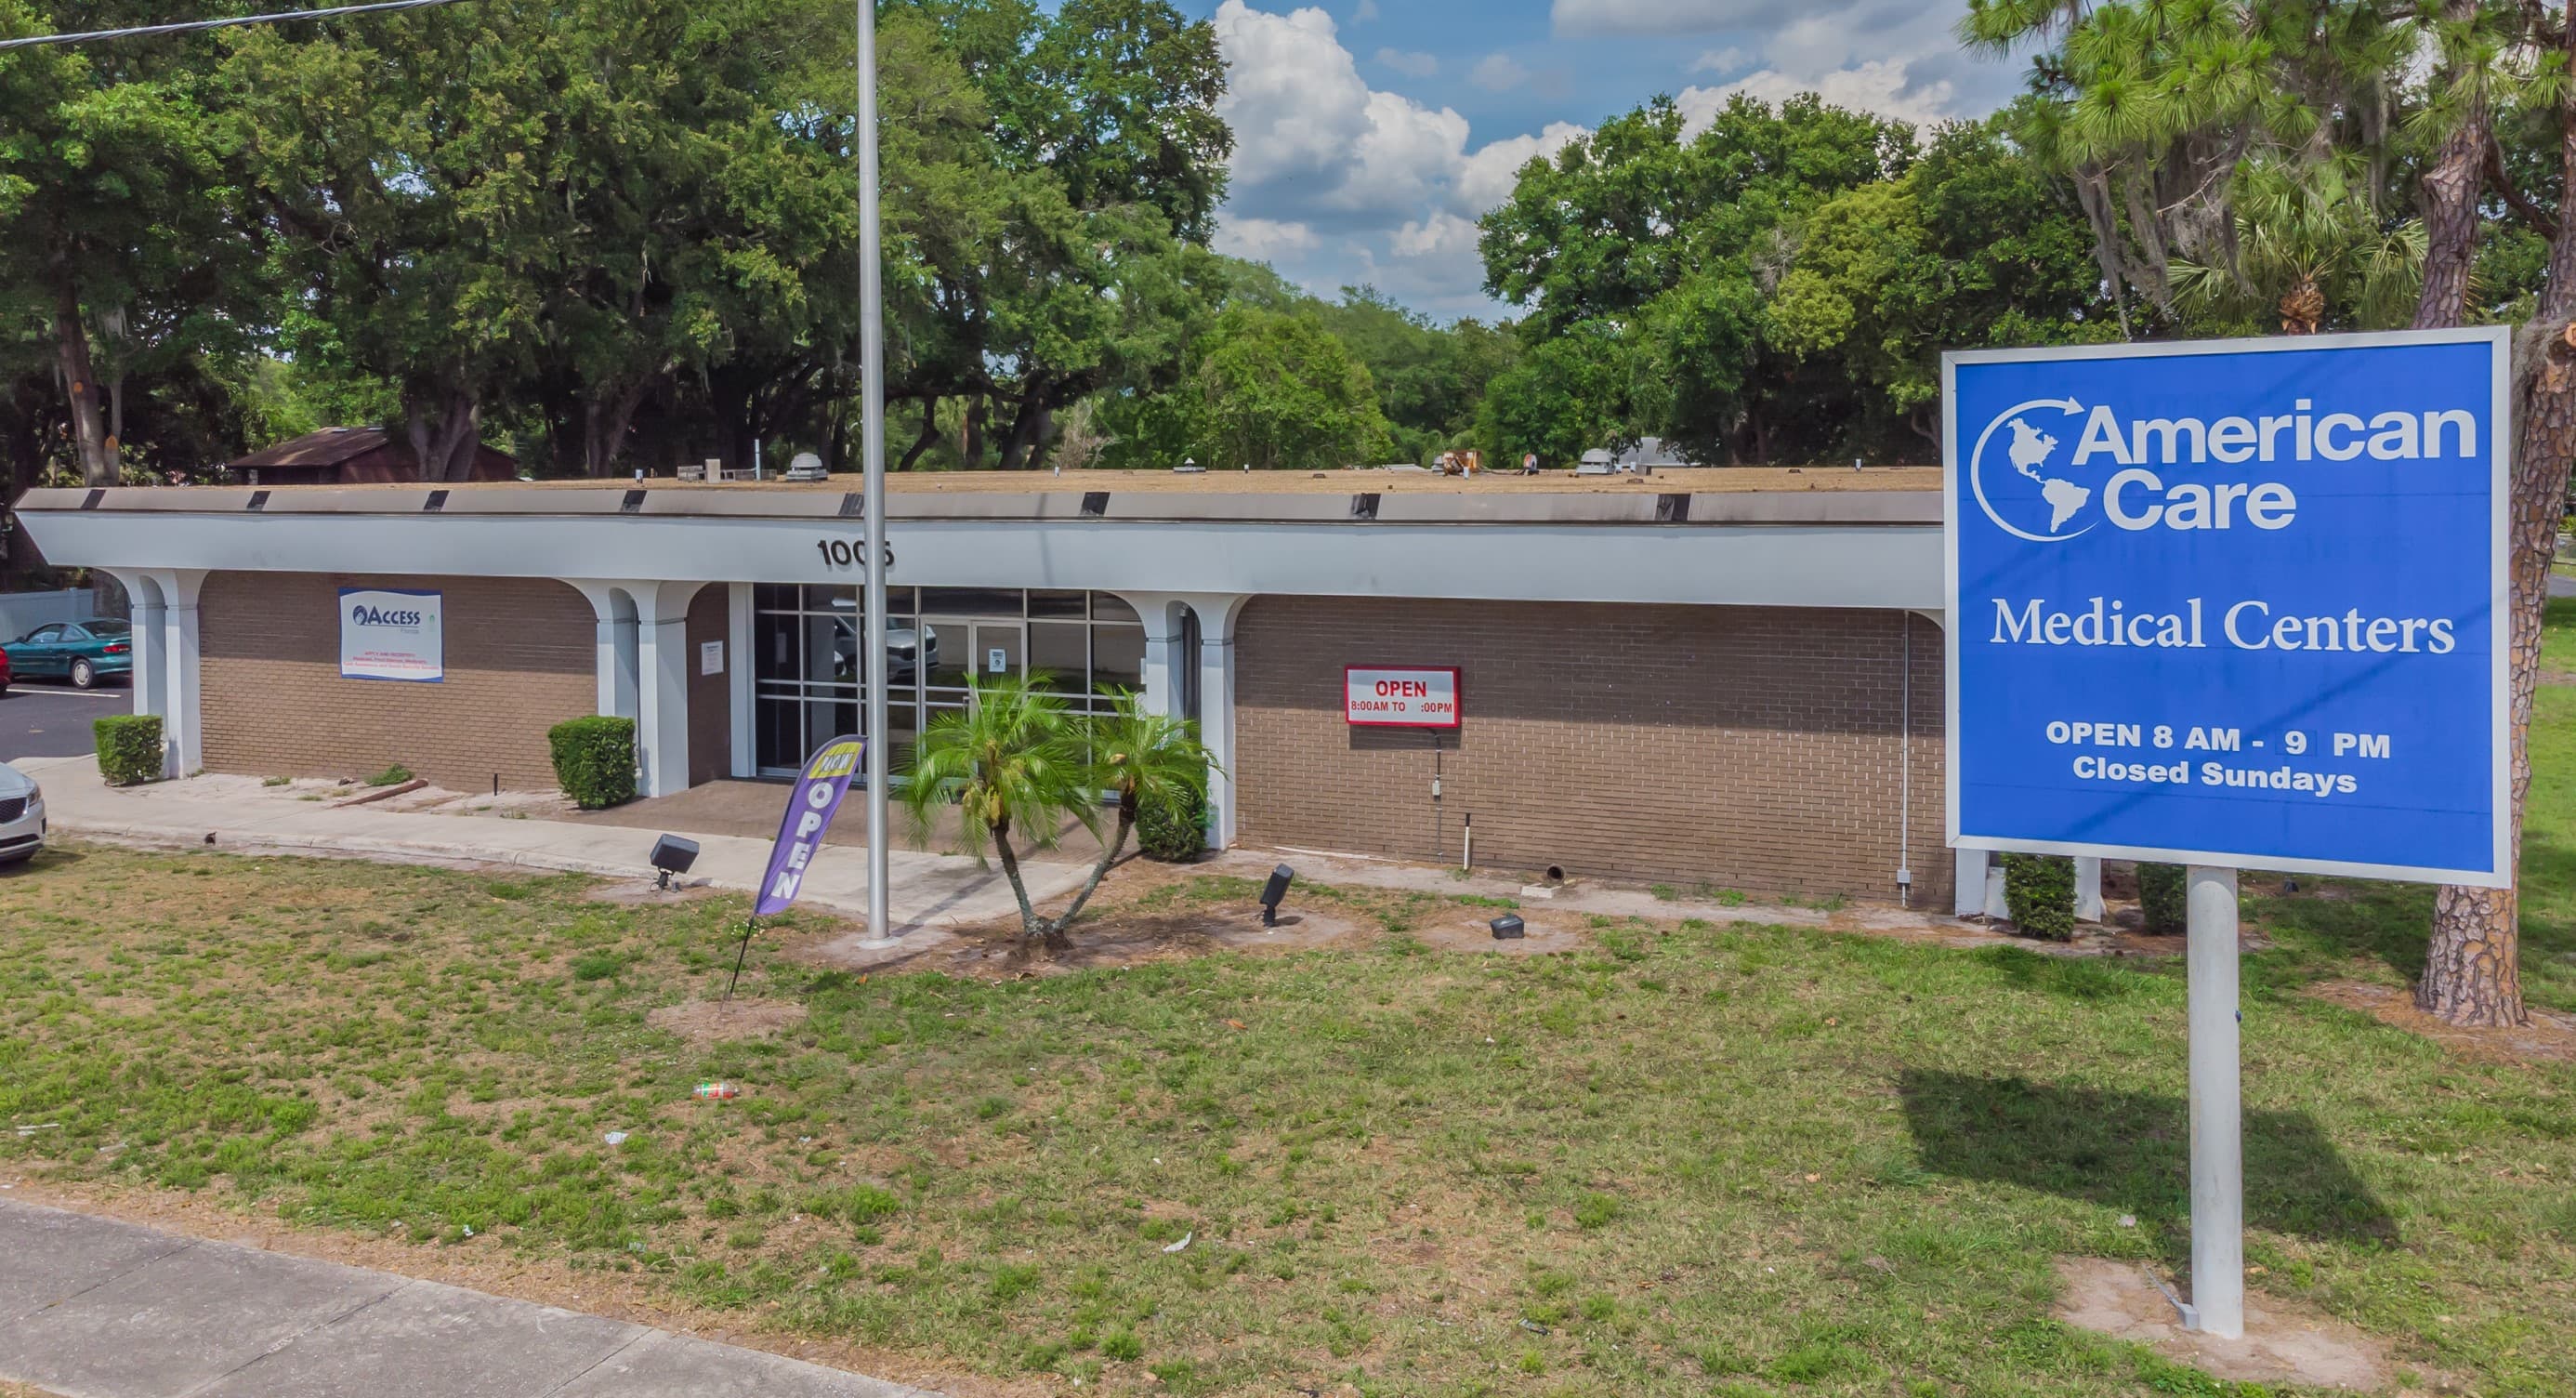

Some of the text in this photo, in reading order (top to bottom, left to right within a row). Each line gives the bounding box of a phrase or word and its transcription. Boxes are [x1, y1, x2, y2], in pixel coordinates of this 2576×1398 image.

[2071, 398, 2477, 467] American
[2103, 468, 2296, 532] Care
[1990, 596, 2455, 653] Medical Centers
[1351, 701, 1388, 712] 8:00AM
[1392, 702, 1406, 712] TO
[1375, 680, 1426, 697] OPEN
[2046, 721, 2141, 746] OPEN
[2152, 725, 2174, 748] 8
[2184, 726, 2241, 751] AM
[2284, 731, 2307, 756] 9
[2333, 733, 2391, 758] PM
[820, 751, 854, 772] NOW
[2072, 756, 2358, 797] Closed Sundays
[770, 782, 835, 899] OPEN
